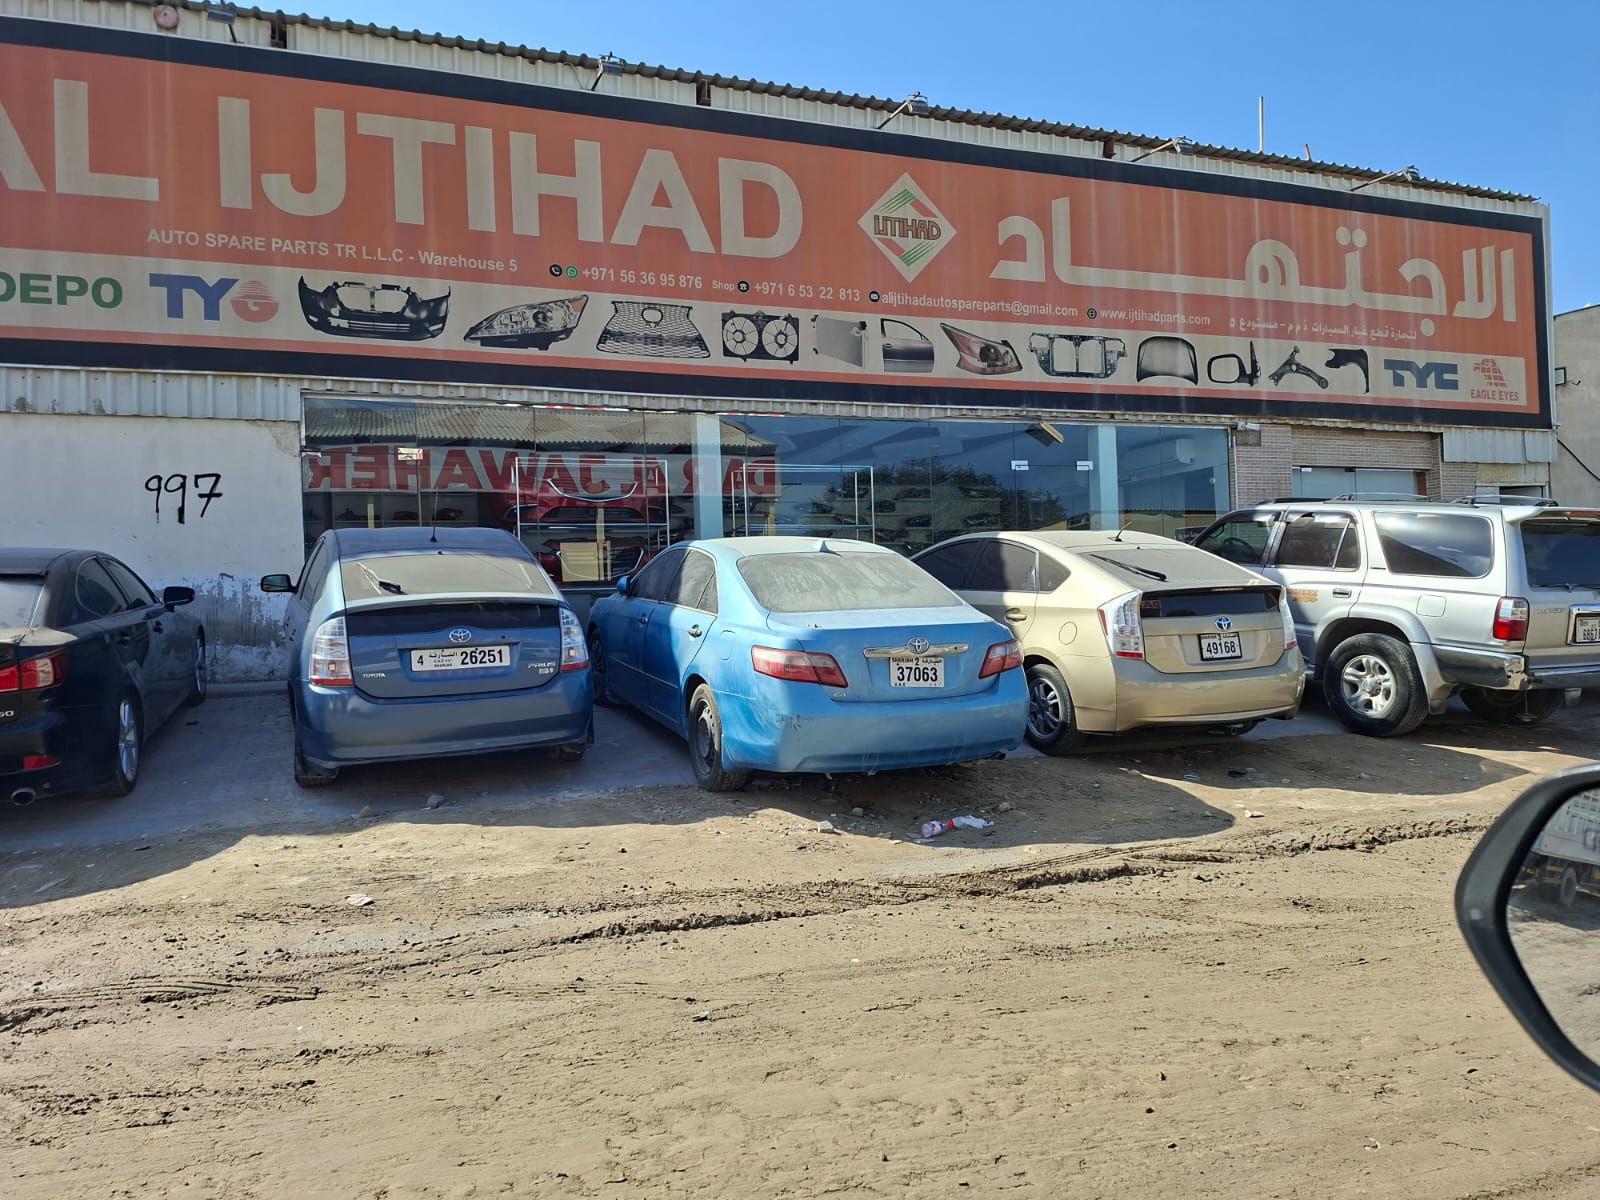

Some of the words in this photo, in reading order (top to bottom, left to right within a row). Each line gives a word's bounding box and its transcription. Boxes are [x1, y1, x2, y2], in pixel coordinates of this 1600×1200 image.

[218, 96, 803, 259] IJTIHAD
[873, 214, 942, 241] IJTIHAD
[147, 228, 200, 246] AUTO
[205, 232, 266, 251] SPARE
[271, 238, 329, 256] PARTS
[334, 243, 357, 259] TR
[362, 245, 404, 262] L.L.C
[418, 250, 505, 271] Warehouse
[509, 259, 518, 272] 5
[583, 266, 615, 282] +971
[620, 269, 636, 284] 56
[640, 271, 656, 285] 36
[660, 273, 676, 287] 95
[679, 275, 703, 289] 876
[712, 279, 735, 292] Shop
[754, 281, 783, 296] +971
[788, 284, 795, 297] 6
[799, 284, 814, 298] 53
[819, 286, 833, 300] 22
[839, 287, 860, 302] 813
[881, 292, 1078, 317] alijtihadautospareparts@gmail.com
[1100, 308, 1211, 325] www.ijtihadparts.com
[1384, 358, 1459, 390] TYC
[1470, 388, 1497, 401] EAGLE
[1499, 391, 1519, 402] EYES
[144, 472, 223, 525] 997
[417, 654, 424, 667] 4
[459, 648, 503, 666] 26251
[1206, 640, 1237, 655] 49168
[897, 666, 938, 682] 37063
